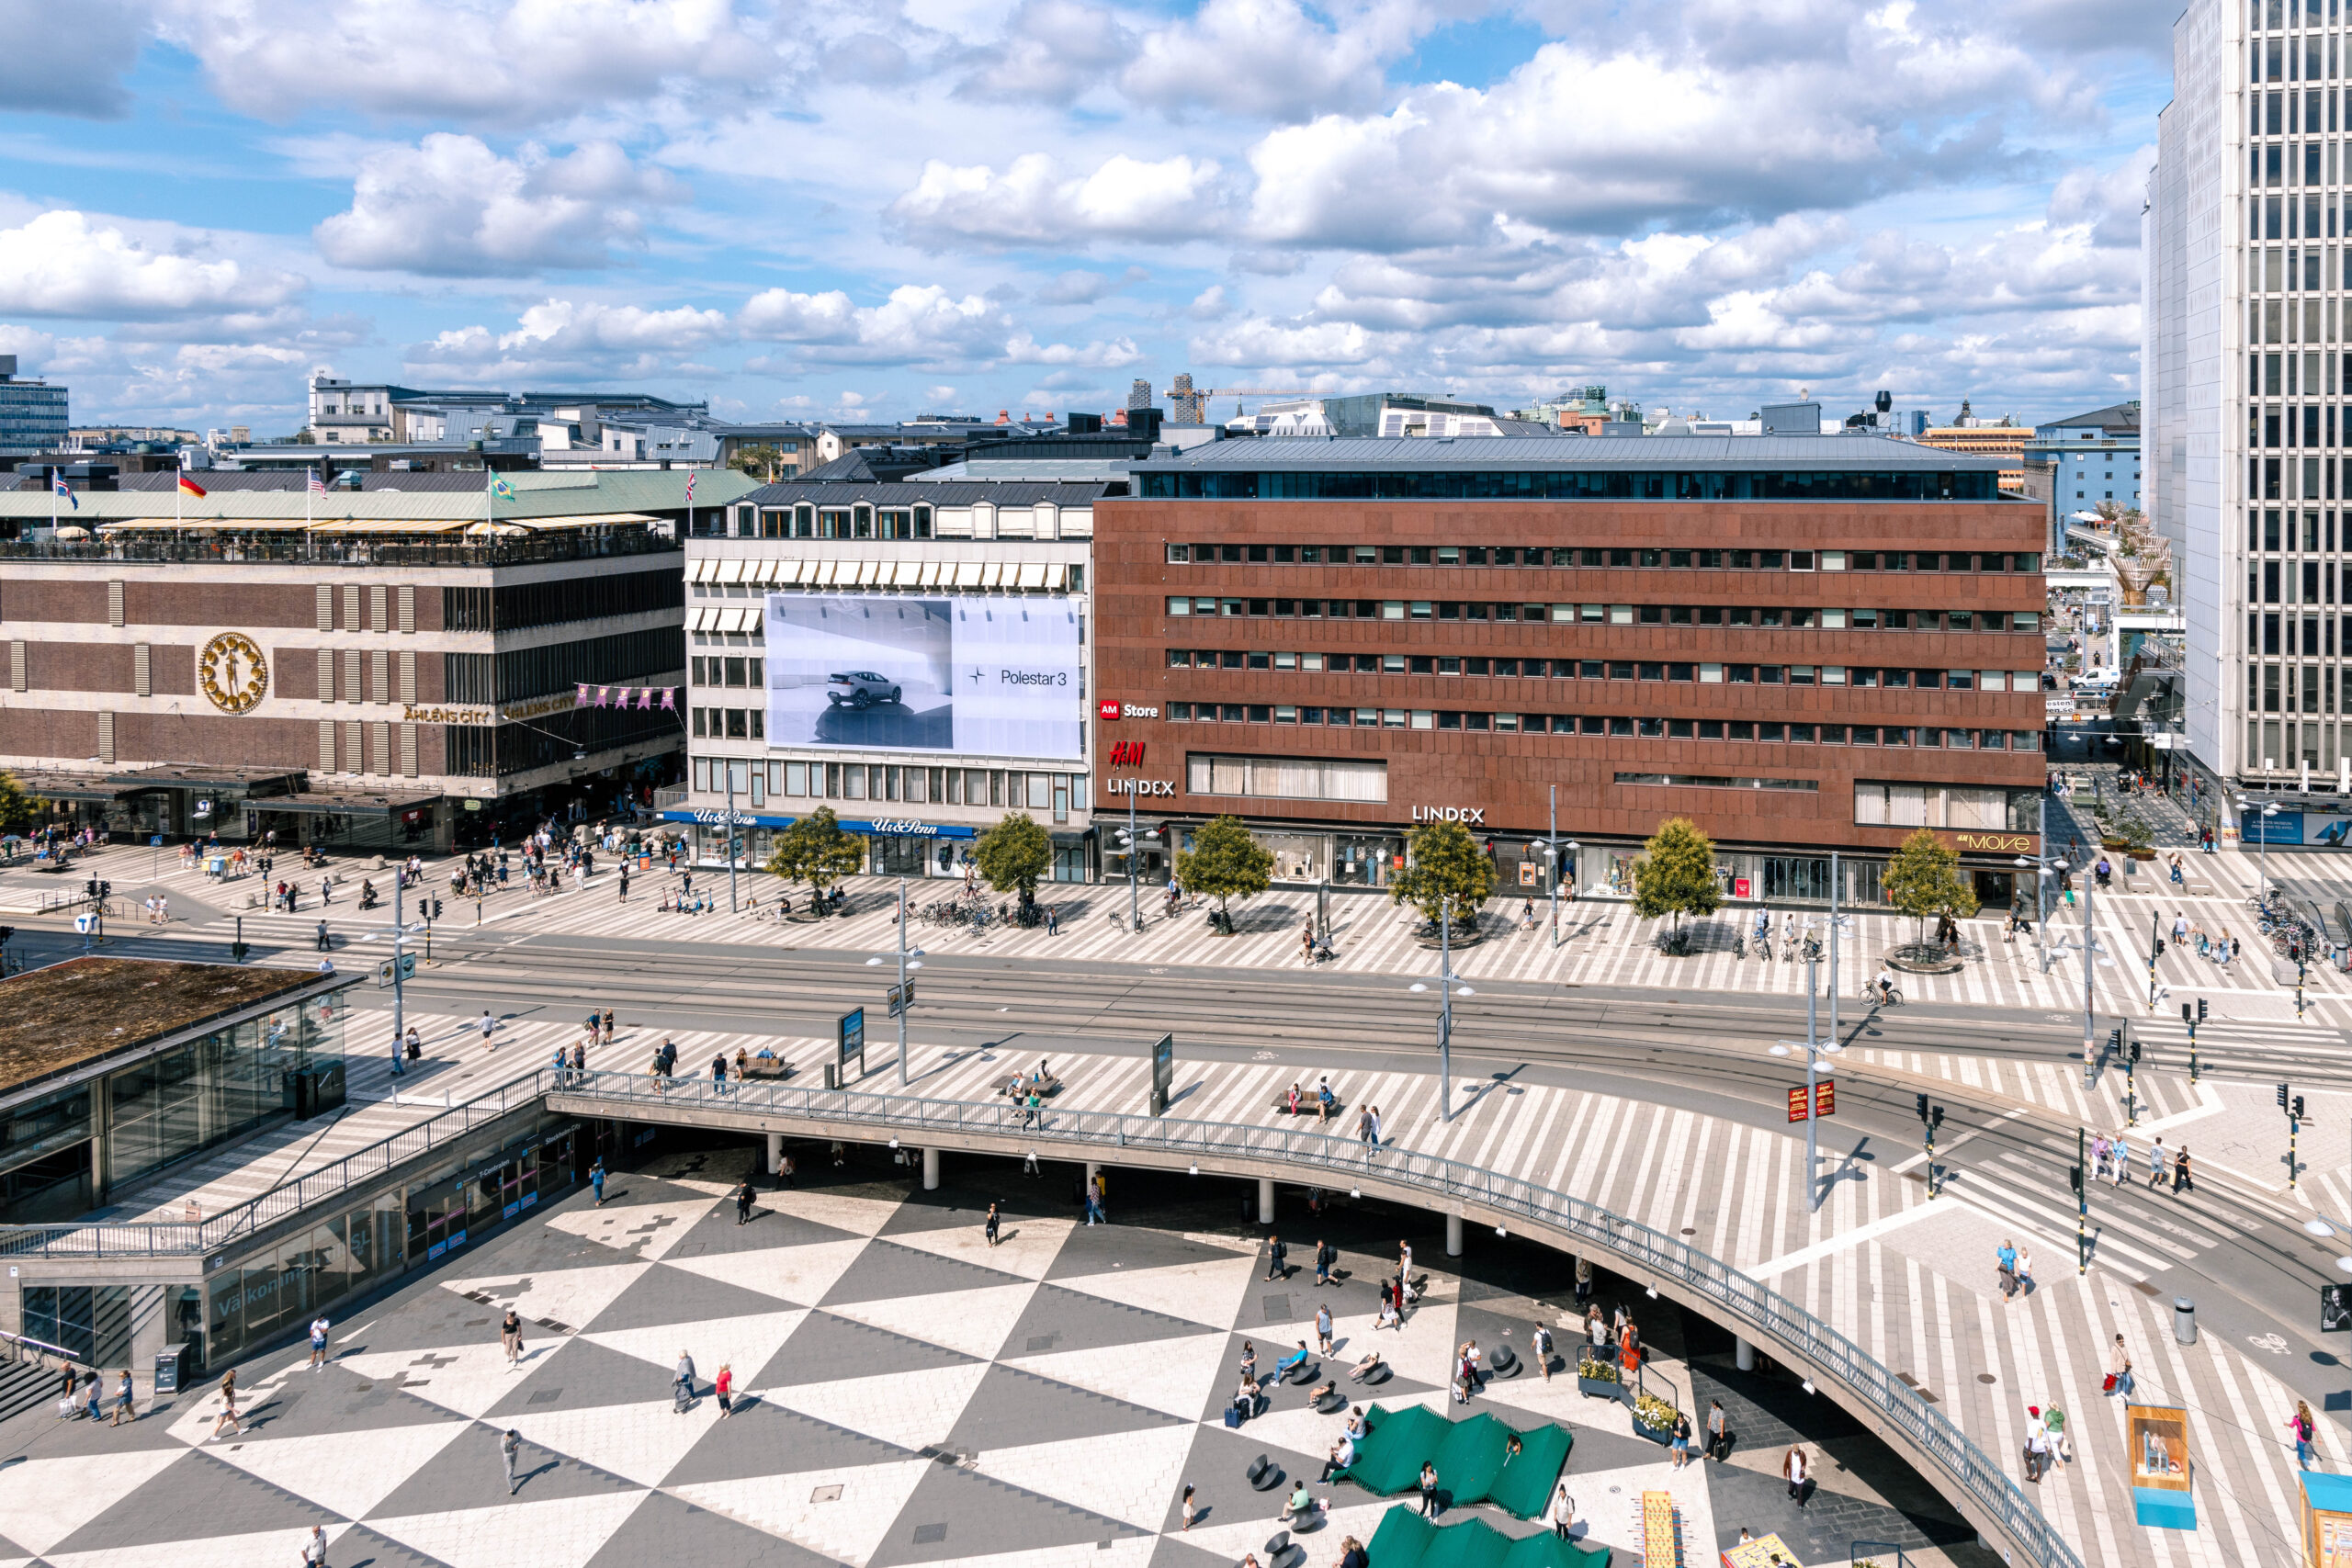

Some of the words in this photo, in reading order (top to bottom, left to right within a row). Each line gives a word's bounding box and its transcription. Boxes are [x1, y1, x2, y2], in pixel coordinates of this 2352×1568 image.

[1001, 670, 1056, 685] Polestar
[1057, 671, 1067, 686] 3
[459, 708, 490, 725] CITY
[1102, 705, 1117, 714] AM
[1124, 705, 1159, 717] Store
[1109, 740, 1145, 767] H&M
[1107, 778, 1175, 795] LINDEX
[1412, 805, 1485, 824] LINDEX
[872, 817, 938, 835] Ur&Penn
[78, 919, 86, 931] T
[479, 1159, 511, 1179] T-Centralen
